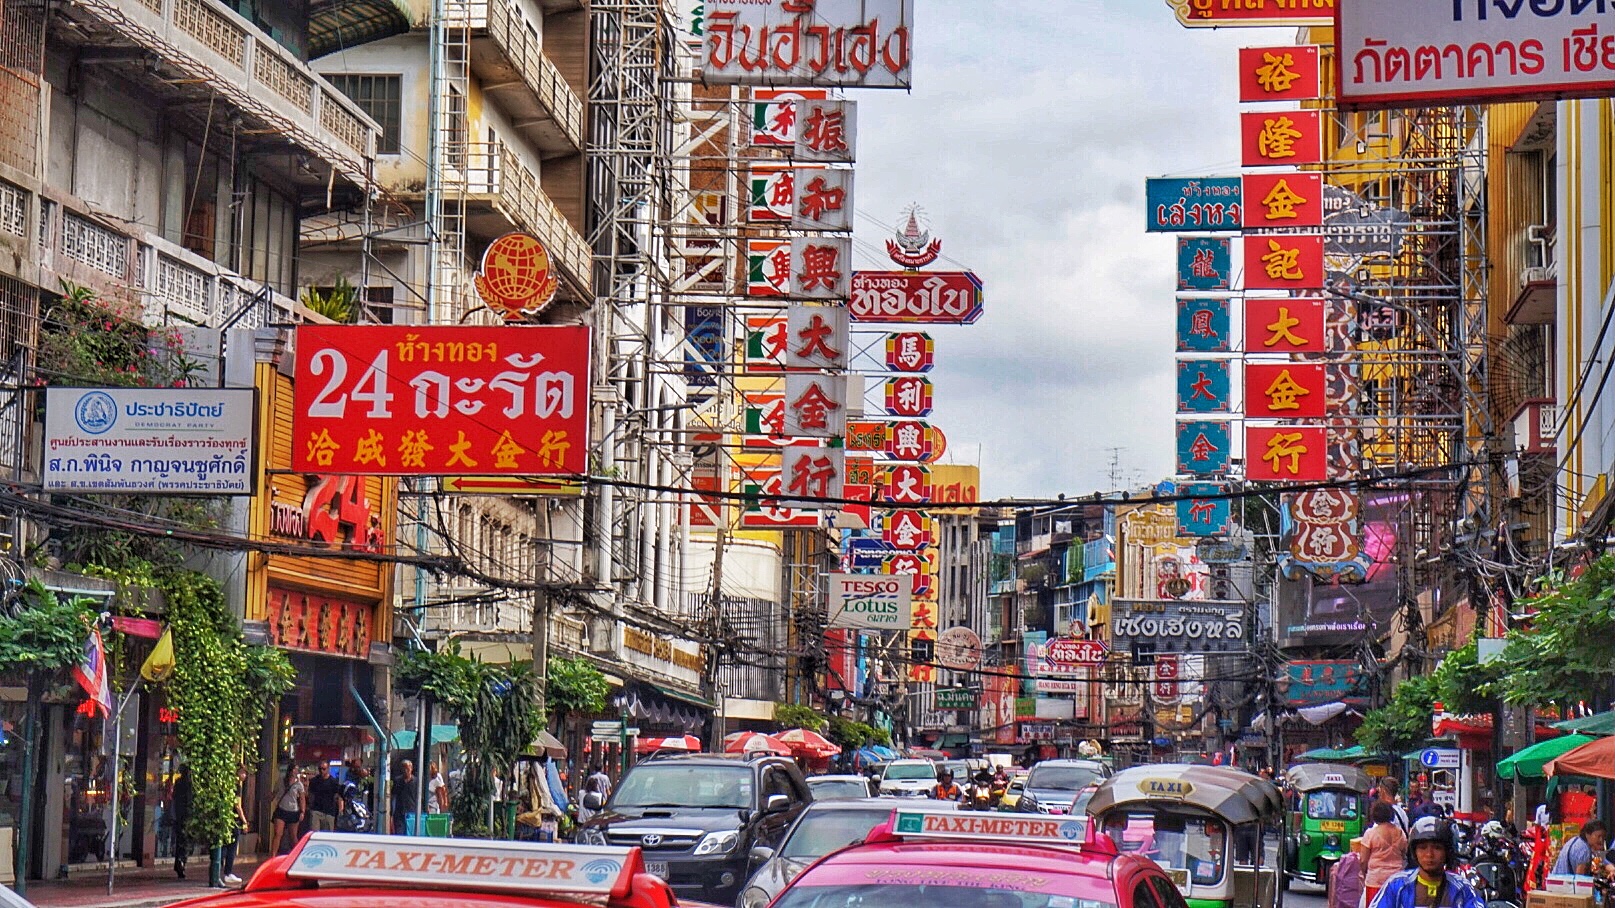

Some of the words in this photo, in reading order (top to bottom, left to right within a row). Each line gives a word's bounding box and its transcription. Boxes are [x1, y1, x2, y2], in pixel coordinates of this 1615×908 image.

[1353, 37, 1545, 84] ภัตตาคาร
[852, 274, 909, 289] ห้างทอง
[395, 333, 498, 363] ห้างทอง
[307, 347, 394, 420] 24
[409, 352, 575, 420] กะรัต
[125, 401, 226, 418] ประชาธิปัตย์
[49, 453, 123, 474] ส.ก.พินิจ
[131, 449, 248, 481] กาญจนชูศักดิ์
[840, 580, 899, 593] TESCO
[843, 598, 898, 613] Lotus
[1149, 781, 1182, 793] TAXI
[923, 815, 1059, 838] TAXI-METER
[344, 848, 576, 880] TAXI-METER
